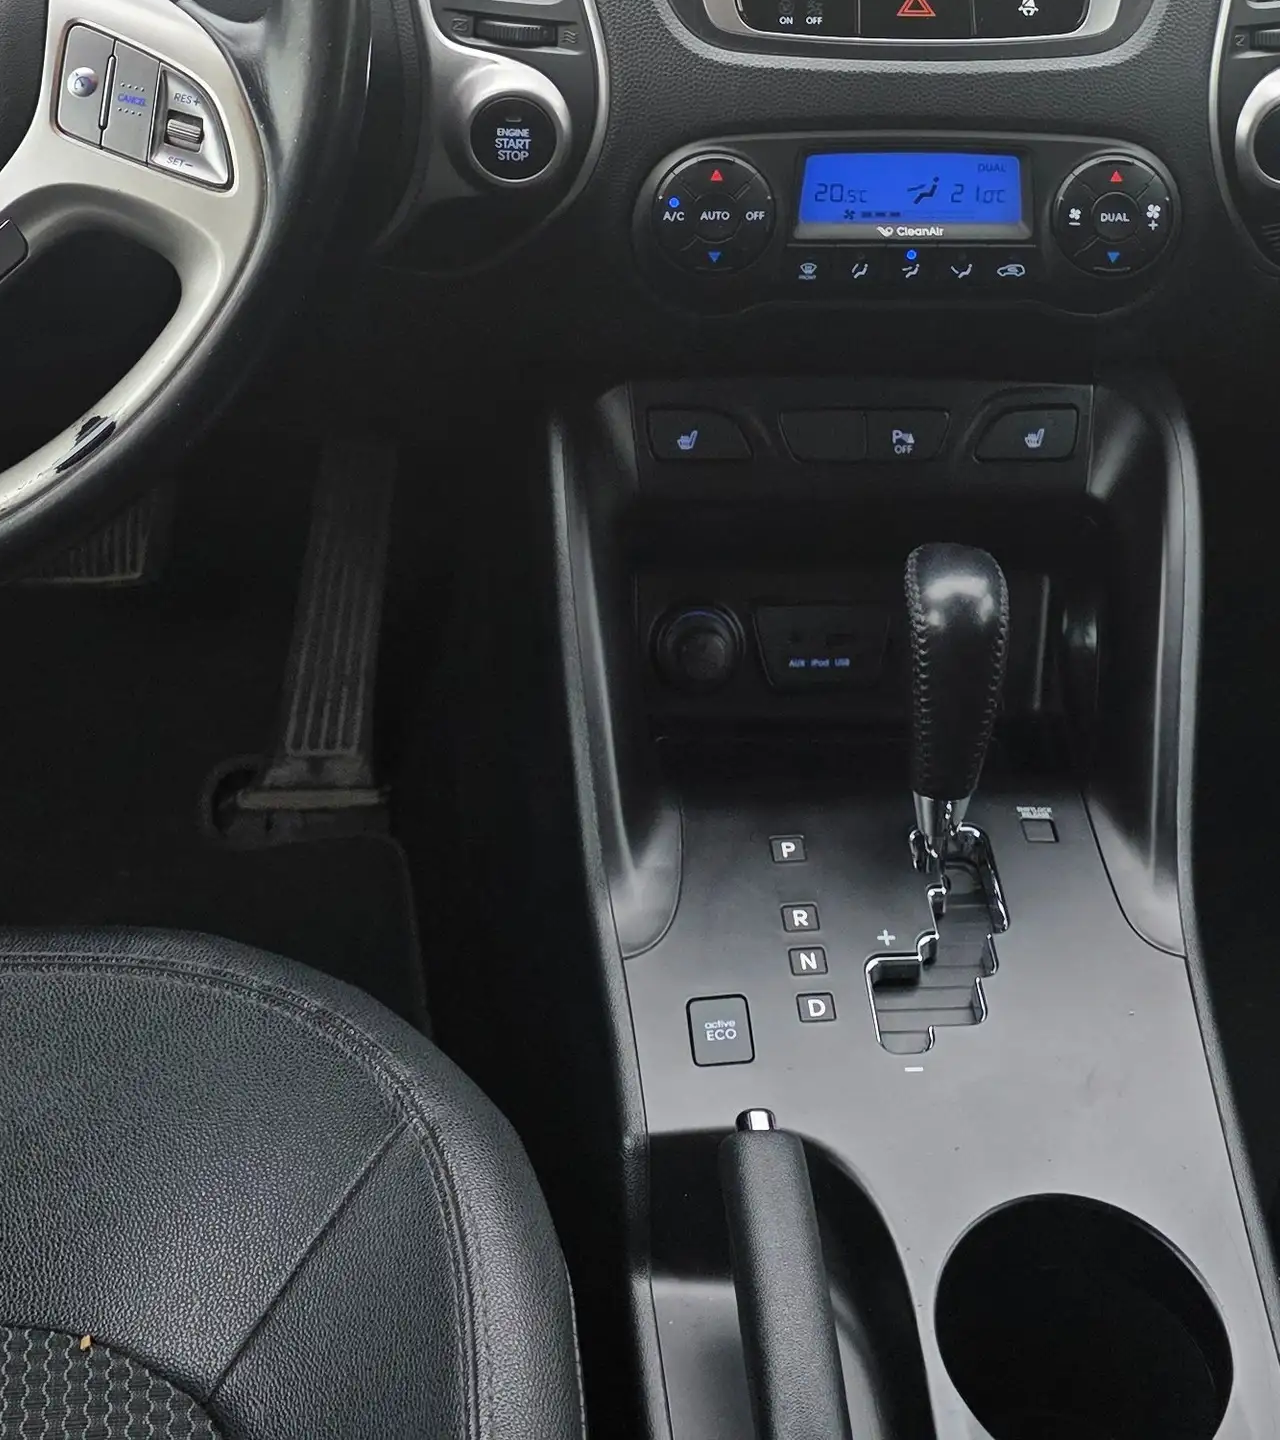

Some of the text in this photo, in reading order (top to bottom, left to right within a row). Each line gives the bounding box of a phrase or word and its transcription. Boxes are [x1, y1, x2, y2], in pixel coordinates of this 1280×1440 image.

[779, 16, 794, 25] ON
[805, 16, 824, 25] OFF
[496, 127, 530, 138] ENGINE
[494, 138, 532, 150] START
[497, 150, 530, 162] STOP
[977, 162, 1006, 173] DUAL
[663, 211, 685, 222] A/C
[700, 210, 731, 221] AUTO
[745, 210, 766, 222] OFF
[1100, 211, 1131, 224] DUAL
[895, 225, 945, 237] CleanAir
[894, 444, 914, 455] OFF
[781, 842, 797, 859] P
[793, 910, 809, 927] R
[799, 951, 818, 971] N
[808, 1000, 827, 1018] D
[704, 1019, 736, 1029] active
[706, 1028, 737, 1041] ECO
